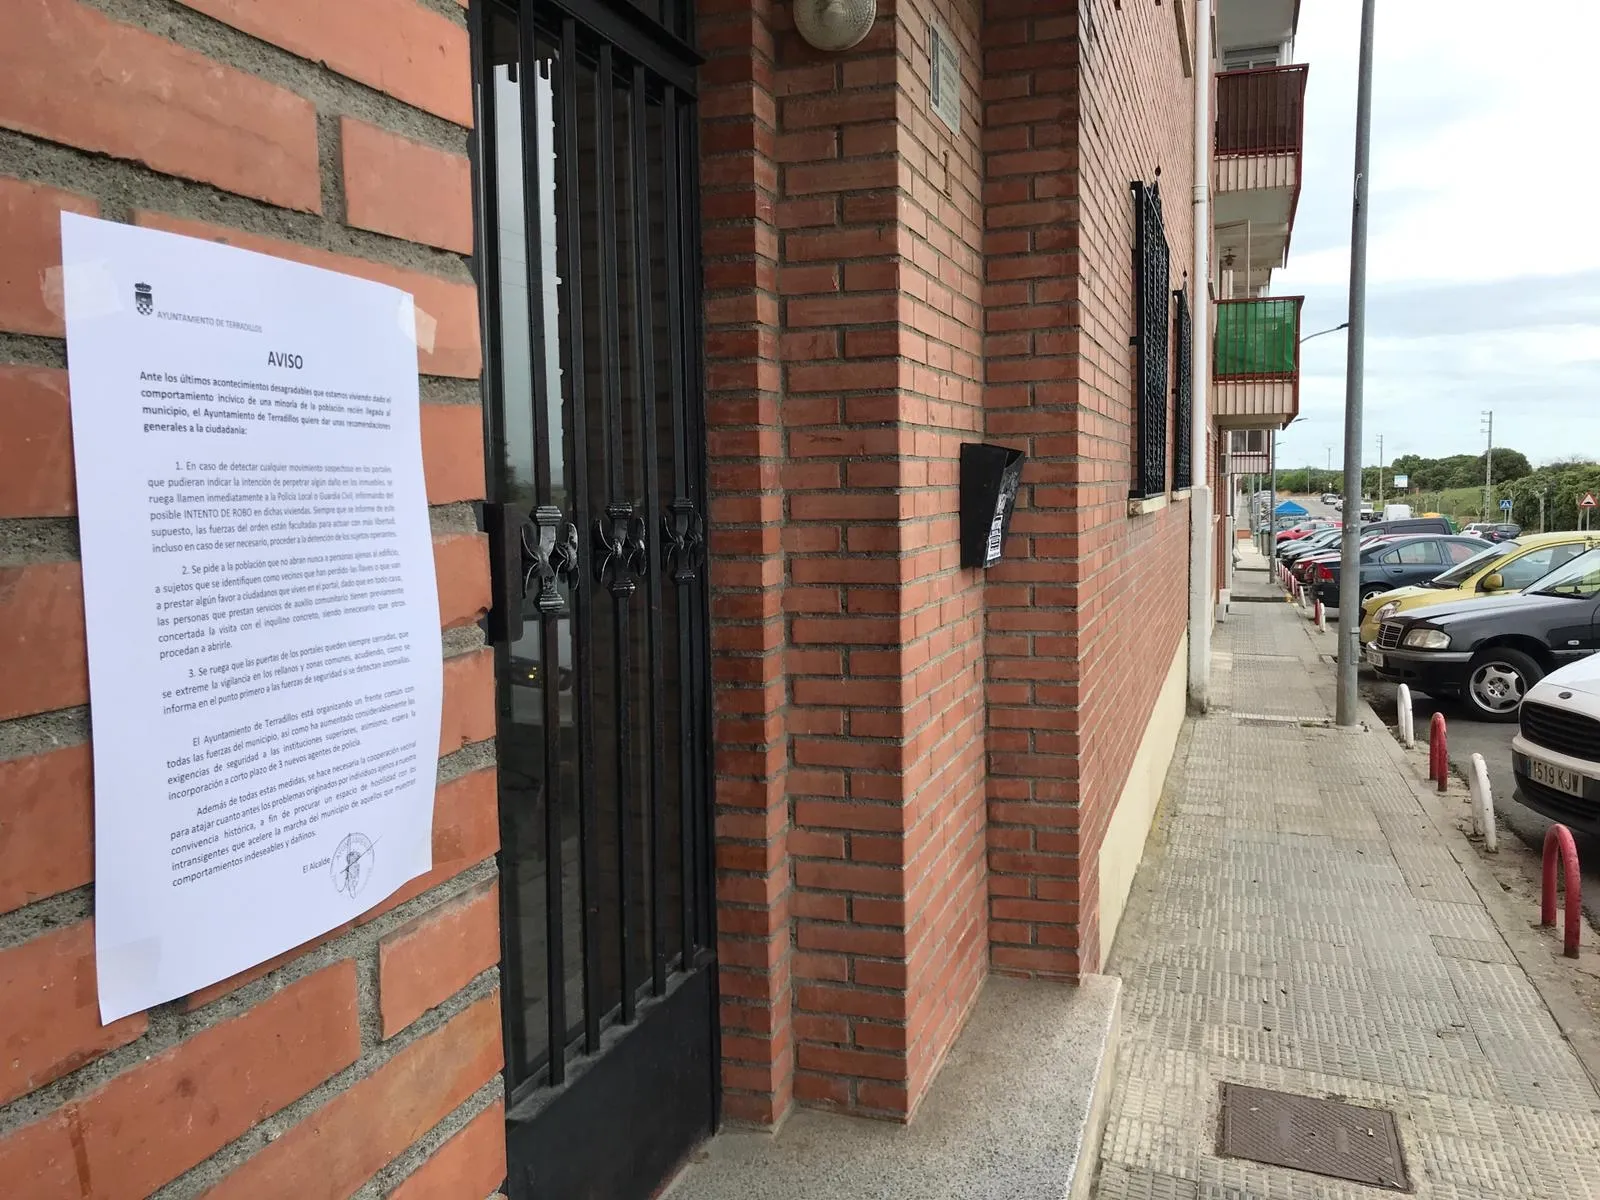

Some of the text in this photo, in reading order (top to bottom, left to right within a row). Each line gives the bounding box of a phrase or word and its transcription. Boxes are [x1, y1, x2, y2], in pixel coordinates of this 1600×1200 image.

[157, 312, 214, 325] AYUNTAMIENTO
[216, 319, 224, 327] DE
[268, 351, 303, 369] AVISO
[140, 372, 312, 396] Ante los últimos acontecimientos desagradables
[141, 390, 307, 409] comportamiento incívico de de
[142, 406, 190, 417] municipio,
[204, 409, 255, 420] Ayuntamiento
[258, 412, 265, 420] de
[268, 413, 298, 423] Terradillos
[144, 423, 187, 432] generales
[196, 424, 203, 432] la
[186, 462, 196, 470] En
[219, 462, 228, 470] de
[230, 462, 258, 471] detectar
[148, 478, 271, 488] que pudieran indicar intención
[149, 495, 174, 505] ruega
[177, 494, 204, 502] llamen
[207, 493, 262, 502] inmediatamente
[298, 492, 312, 500] Local
[150, 510, 181, 521] posible
[184, 510, 218, 518] INTENTO
[221, 509, 230, 517] DE
[233, 508, 252, 516] ROBO
[152, 523, 268, 538] supuesto, las fuerzas del orden
[152, 543, 183, 553] incluso
[196, 542, 213, 550] caso
[215, 540, 223, 549] de
[237, 538, 268, 548] necesario,
[182, 566, 190, 575] 2.
[192, 565, 201, 574] Se
[203, 564, 219, 574] pide
[227, 562, 233, 570] la
[235, 560, 266, 571] población
[268, 559, 279, 568] que
[163, 584, 193, 594] sujetos
[196, 582, 209, 592] que
[222, 576, 261, 588] identifiquen
[263, 575, 280, 583] como
[156, 602, 161, 610] a
[164, 599, 193, 611] prestar
[196, 596, 216, 607] algún
[218, 593, 235, 603] favor
[243, 589, 277, 600] ciudadanos
[279, 588, 290, 596] que
[157, 603, 282, 626] las personas que prestan servicios
[158, 629, 205, 642] concertada
[209, 627, 215, 636] la
[219, 626, 237, 635] visita
[240, 623, 252, 631] con
[256, 620, 261, 628] el
[160, 645, 199, 660] procedan
[208, 640, 232, 651] abrirle.
[199, 650, 298, 676] Se ruega que las puertas de los
[162, 690, 172, 698] se
[176, 683, 208, 696] extreme
[212, 681, 218, 689] la
[221, 675, 250, 688] vigilancia
[263, 669, 272, 678] los
[164, 675, 312, 715] informa en el punto primero las de
[193, 736, 200, 746] El
[204, 726, 251, 744] Ayuntamiento
[265, 710, 298, 728] Terradillos
[167, 727, 308, 768] todas las fuerzas del como
[168, 767, 209, 784] exigencias
[214, 764, 222, 772] de
[227, 753, 259, 768] seguridad
[1533, 761, 1579, 792] 1519 KJW
[168, 779, 223, 800] incorporación
[230, 773, 248, 783] corto
[250, 766, 267, 778] plazo
[269, 763, 277, 771] de
[197, 786, 276, 816] Además de todas estas
[171, 803, 270, 841] para atajar cuanto antes los
[171, 835, 218, 855] convivencia
[224, 824, 256, 838] histórica,
[269, 814, 277, 823] fin
[282, 810, 290, 818] de
[172, 847, 229, 871] intransigentes
[232, 842, 245, 852] que
[248, 831, 272, 846] acelere
[310, 813, 319, 823] del
[173, 858, 243, 886] comportamientos
[244, 844, 284, 861] indeseables
[310, 857, 330, 870] Alcalde
